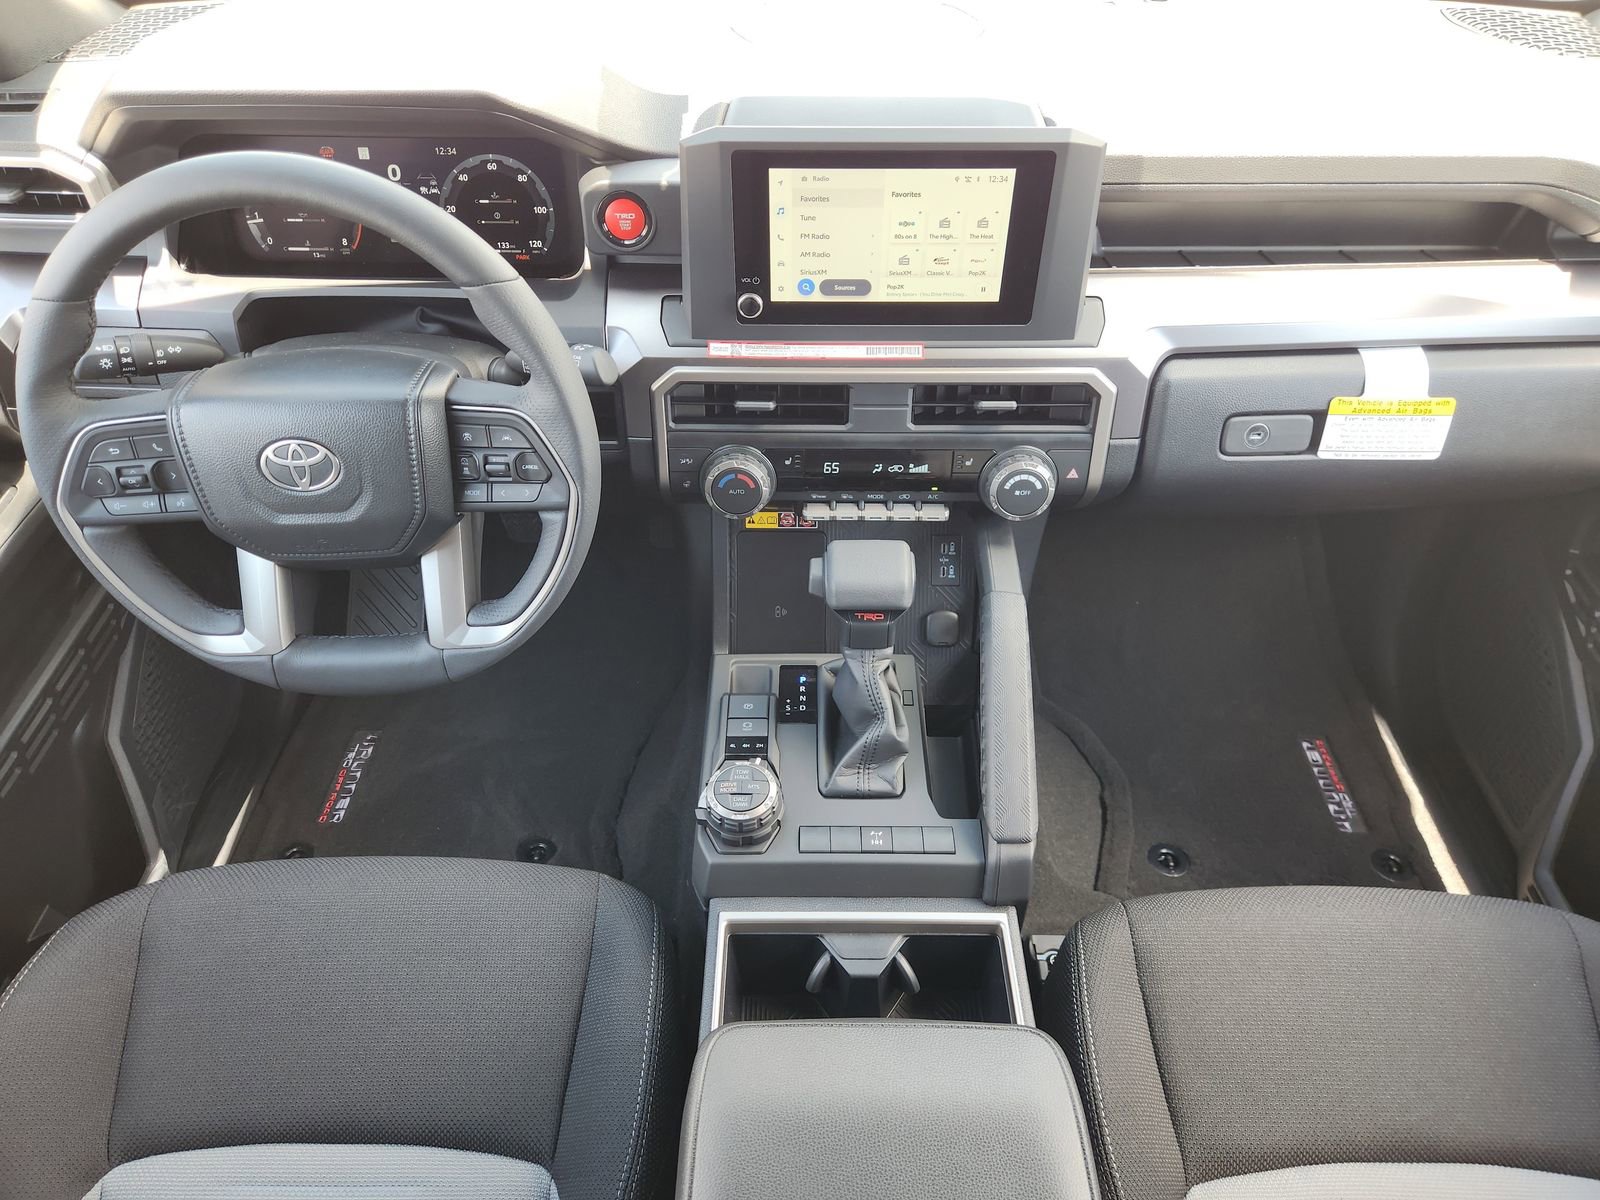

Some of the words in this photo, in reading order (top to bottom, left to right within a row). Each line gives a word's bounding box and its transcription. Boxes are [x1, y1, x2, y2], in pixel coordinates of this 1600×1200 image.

[435, 147, 456, 155] 12:34
[487, 162, 497, 171] 60
[387, 164, 401, 182] 0
[458, 174, 468, 182] 40
[517, 174, 528, 182] 80
[989, 175, 1009, 183] 12:34
[800, 195, 830, 203] Favorites
[446, 205, 456, 213] 20
[533, 206, 547, 214] 100
[800, 214, 817, 222] Tune
[267, 236, 273, 245] 0
[342, 237, 348, 246] 8
[528, 240, 542, 248] 120
[800, 251, 811, 259] AM
[812, 251, 831, 259] Radio
[1397, 399, 1432, 408] Equipped
[823, 462, 840, 474] 65
[854, 612, 885, 621] TRD
